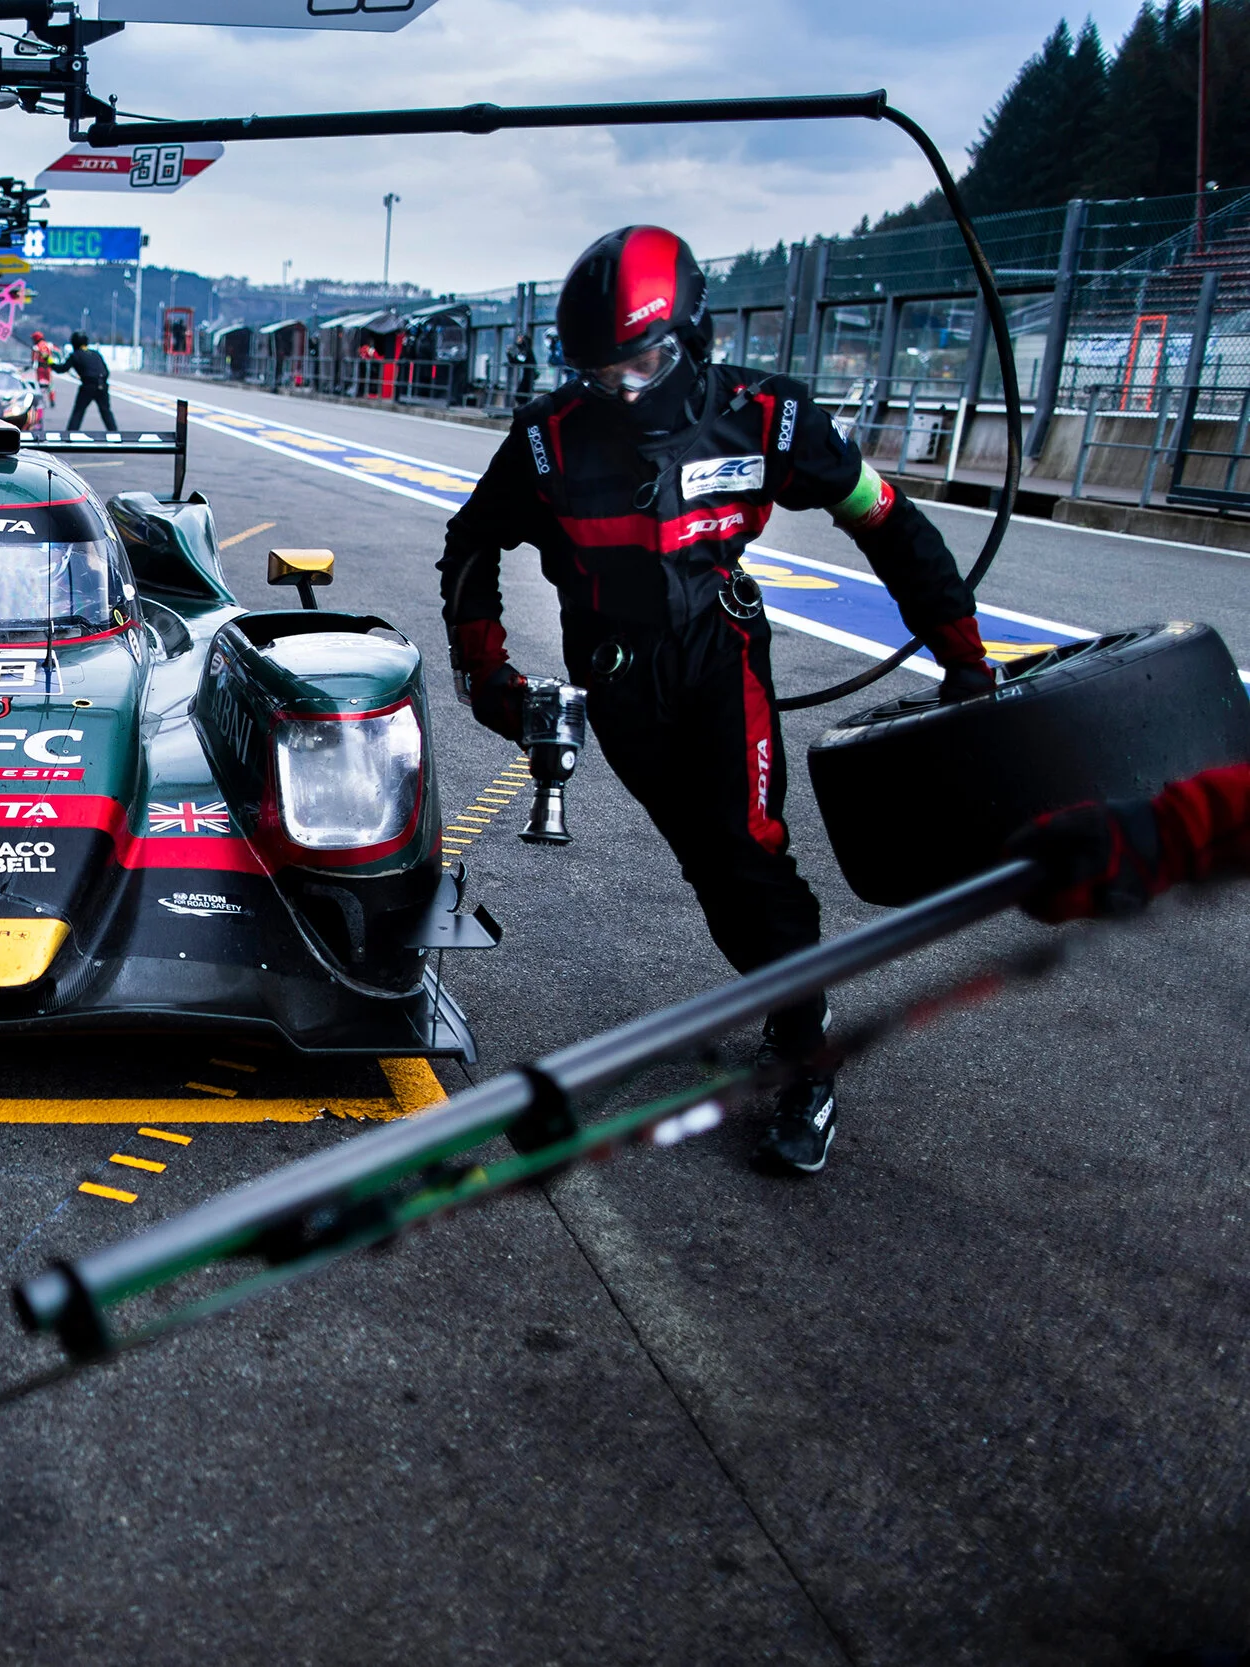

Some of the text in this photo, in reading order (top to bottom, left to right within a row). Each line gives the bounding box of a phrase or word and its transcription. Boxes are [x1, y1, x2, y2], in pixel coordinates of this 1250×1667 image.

[72, 144, 184, 188] JOTA 38
[624, 297, 667, 327] JOTA
[777, 400, 798, 451] sparco
[527, 425, 550, 474] sparco
[688, 460, 760, 482] WEC
[678, 512, 744, 540] JOTA
[219, 686, 253, 766] BNI
[756, 738, 769, 820] JOTA
[187, 900, 210, 908] ROAD
[210, 902, 242, 912] SAFETY
[188, 893, 226, 904] ACTION
